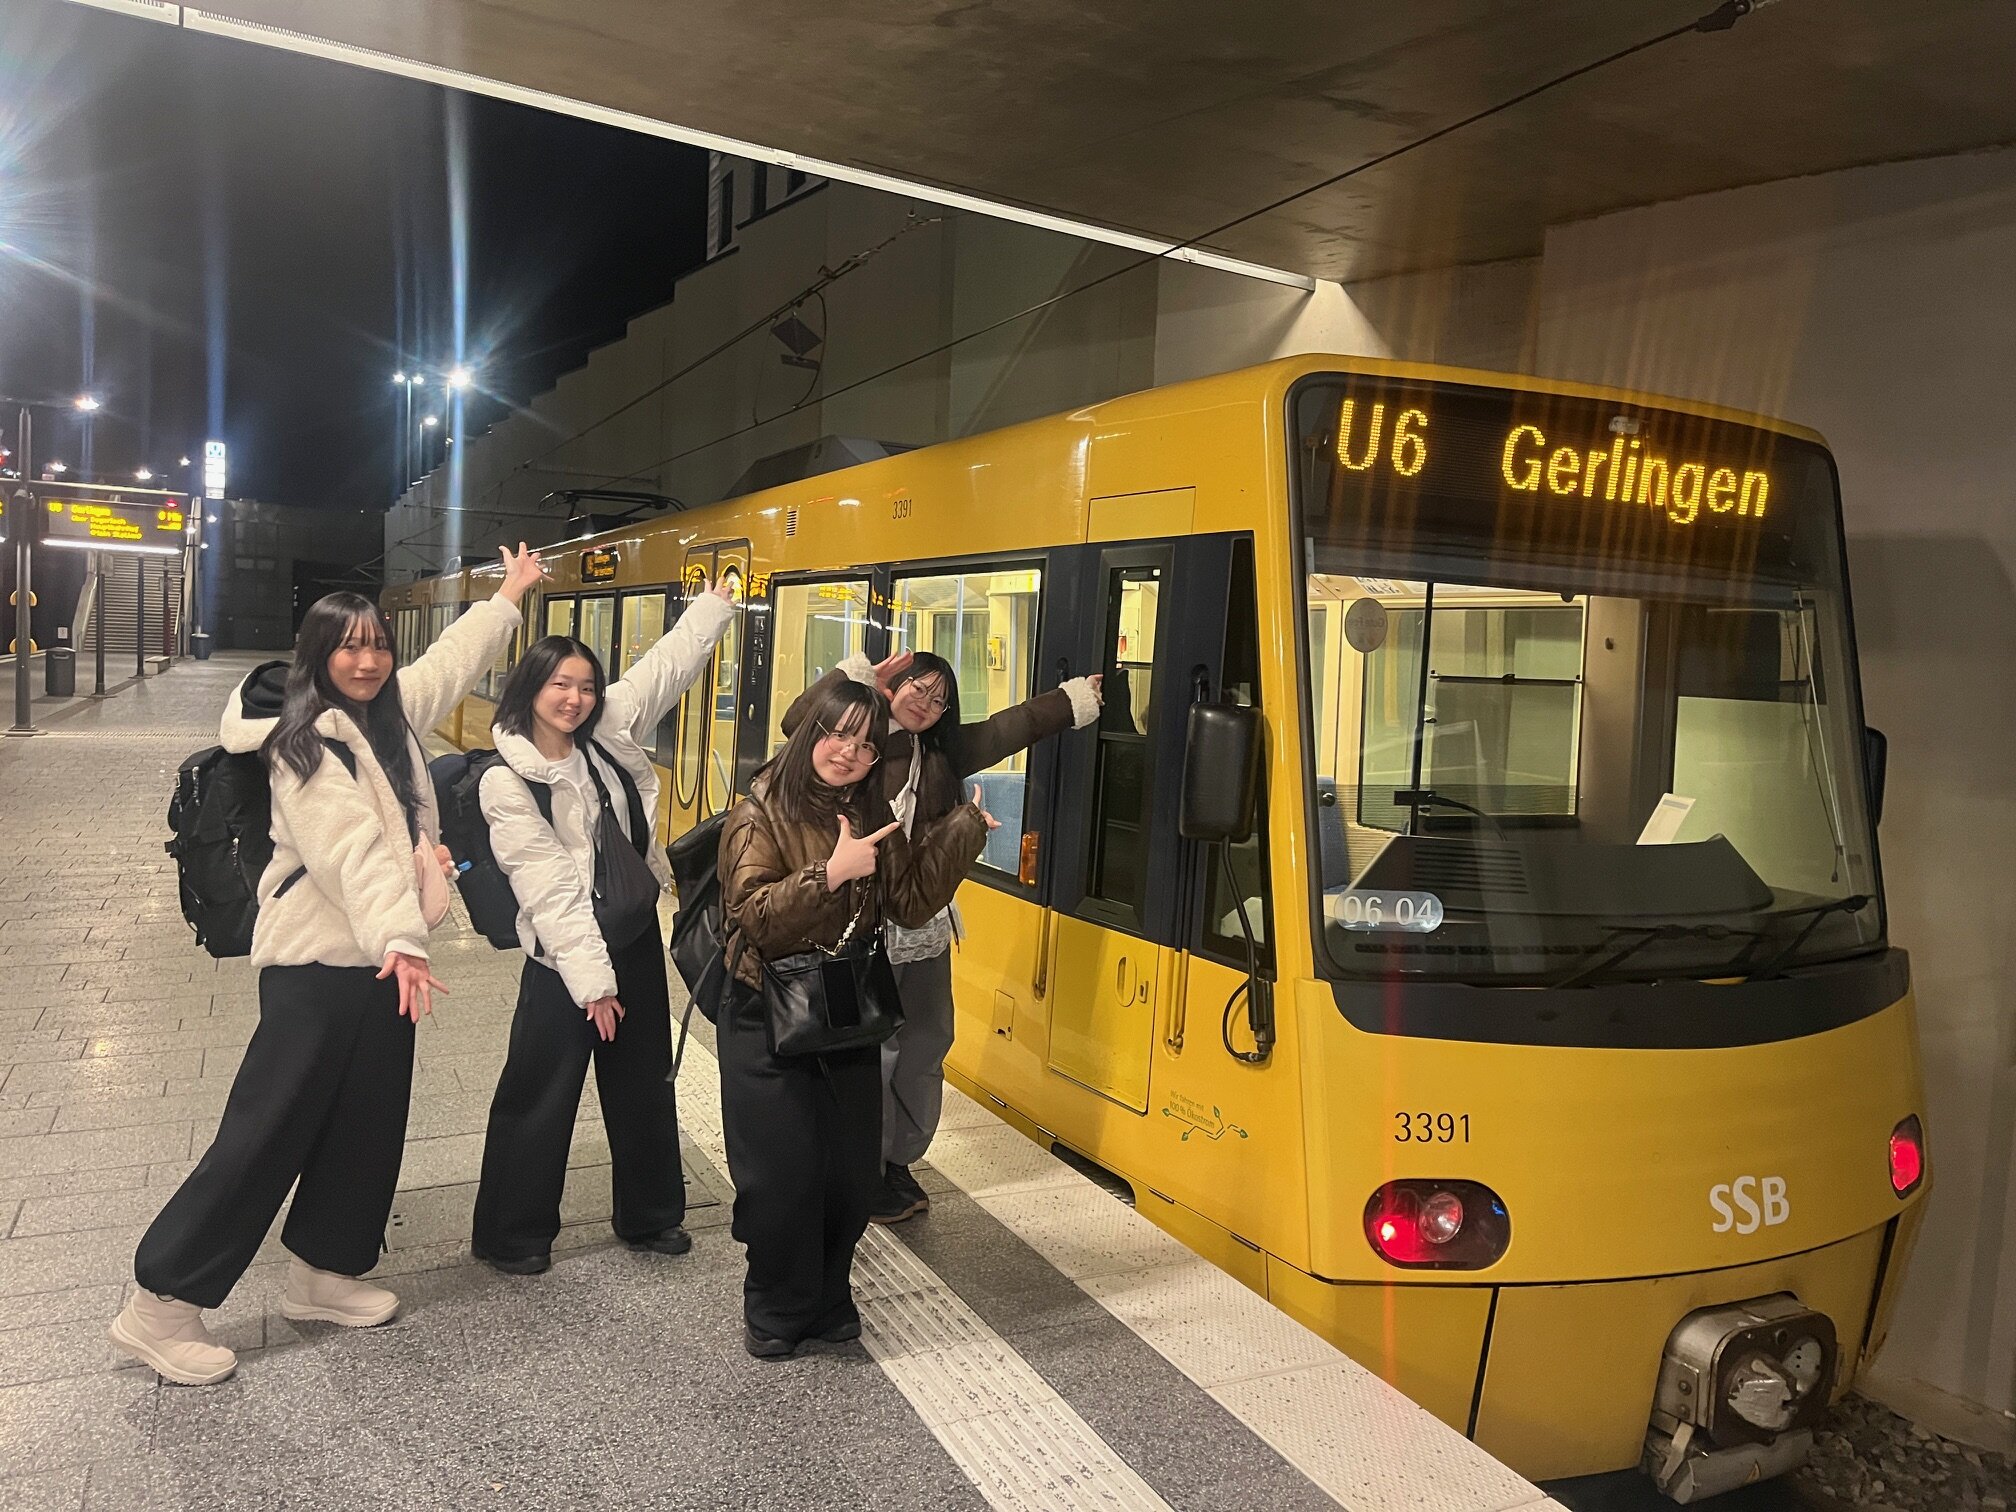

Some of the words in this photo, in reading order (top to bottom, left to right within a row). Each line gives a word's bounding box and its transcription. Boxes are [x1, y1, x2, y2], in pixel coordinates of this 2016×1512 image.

[1337, 399, 1428, 477] U6
[1502, 424, 1769, 524] Gerlingen
[892, 499, 912, 520] 3391
[1343, 896, 1383, 925] 06
[1395, 897, 1434, 926] 04
[1187, 1107, 1215, 1129] Ökostrom
[1394, 1112, 1470, 1143] 3391
[1709, 1175, 1790, 1235] SSB
